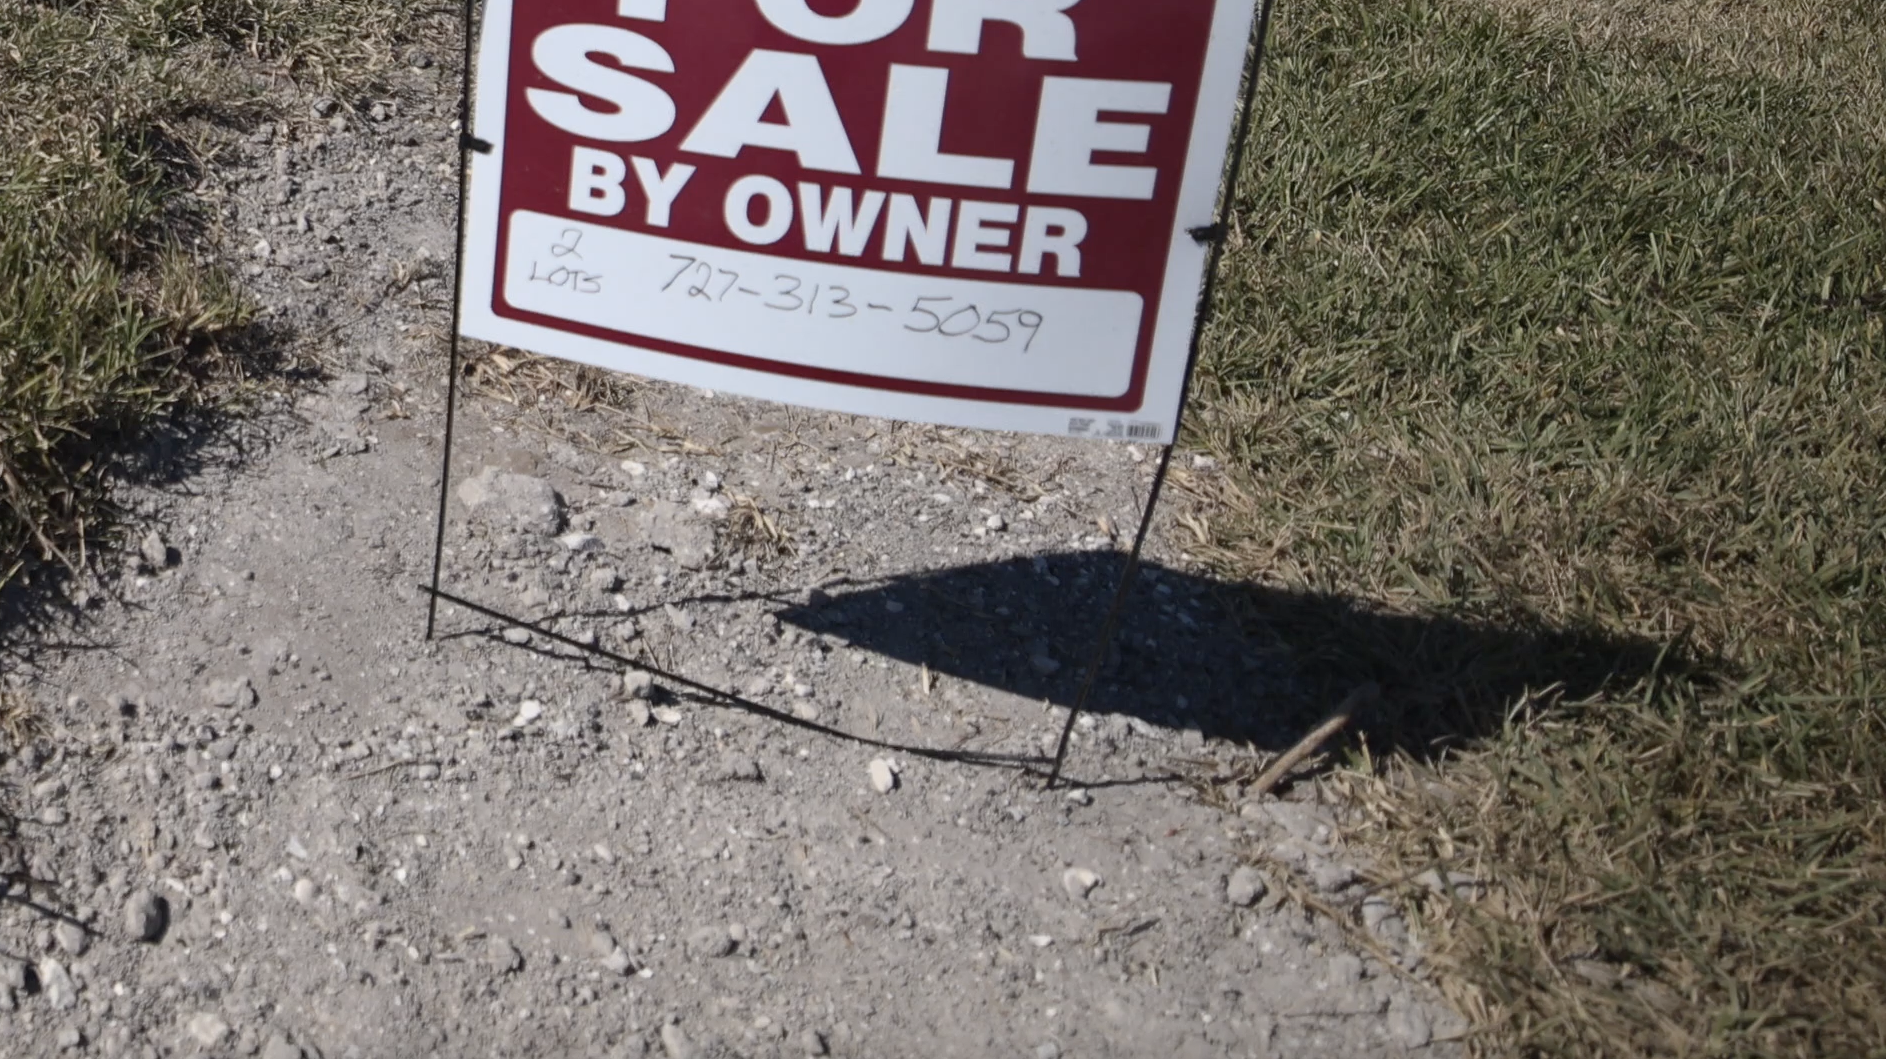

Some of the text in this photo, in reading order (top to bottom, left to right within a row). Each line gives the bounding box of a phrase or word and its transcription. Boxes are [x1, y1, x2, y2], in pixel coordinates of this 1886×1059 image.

[525, 23, 1173, 200] SALE
[550, 228, 584, 260] 2
[567, 145, 1088, 278] BY OWNER
[660, 252, 1044, 354] 727-313-5059
